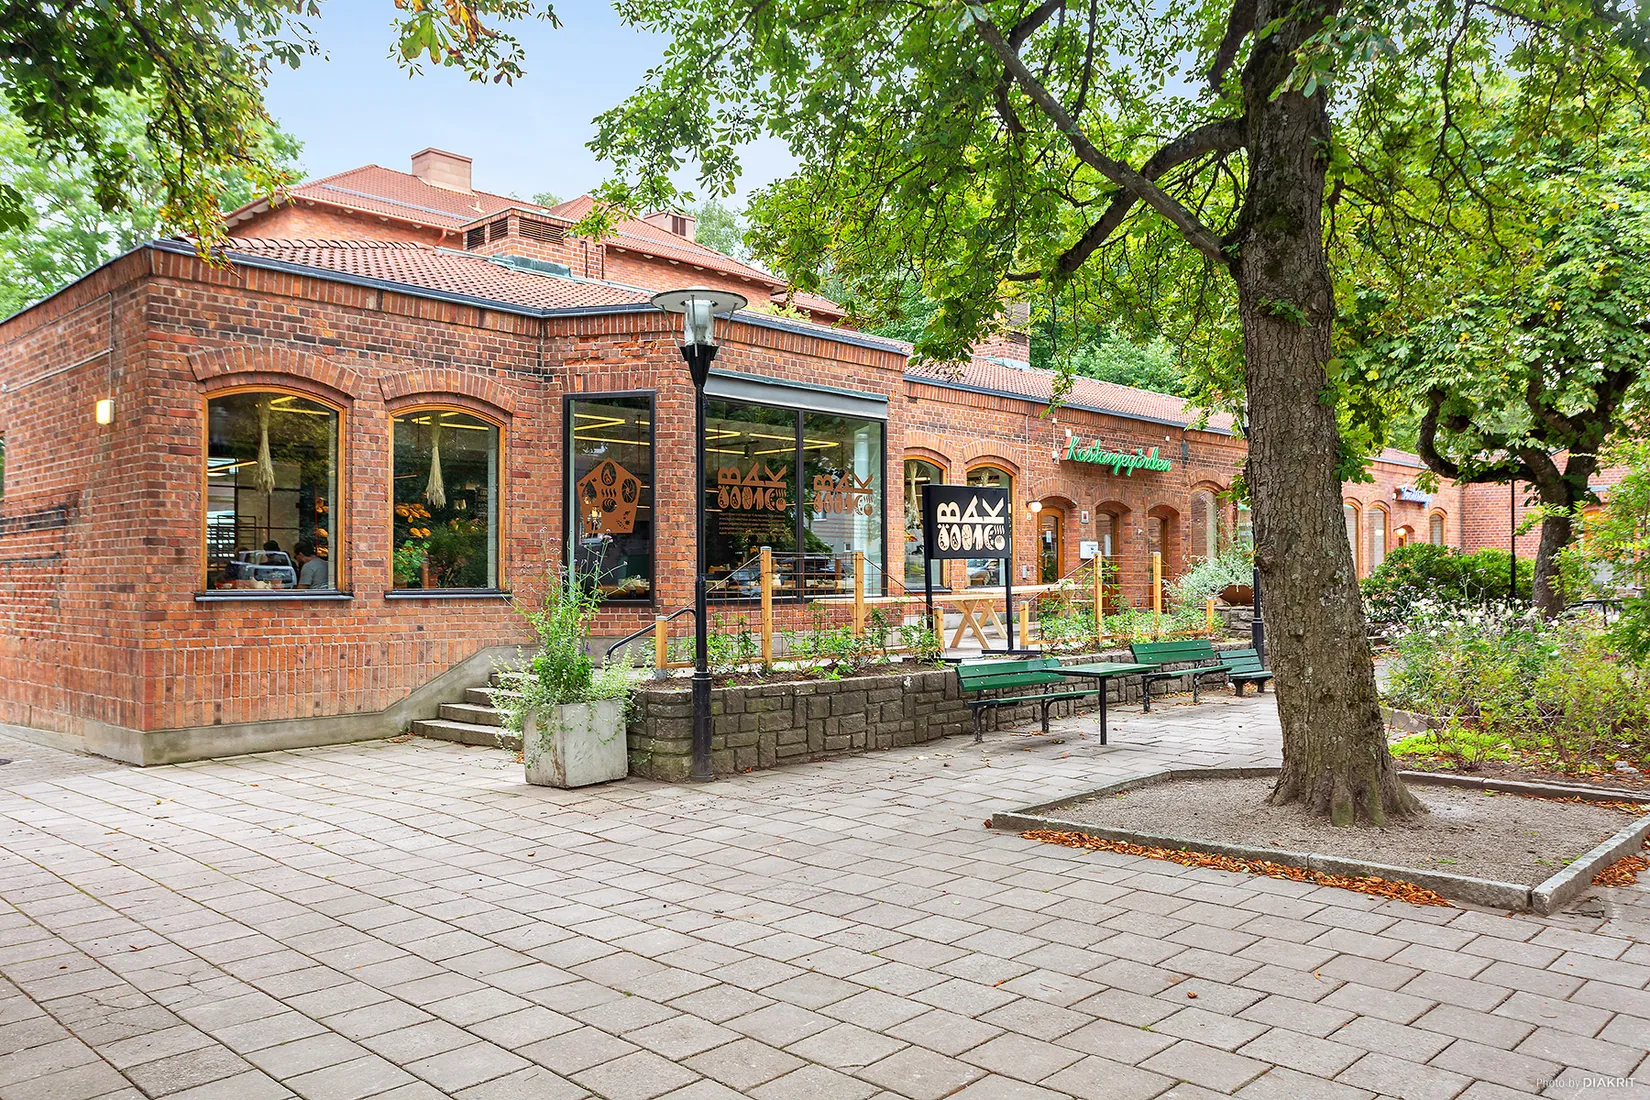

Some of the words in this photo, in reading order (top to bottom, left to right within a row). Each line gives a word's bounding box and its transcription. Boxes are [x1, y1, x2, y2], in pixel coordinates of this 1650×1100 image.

[717, 462, 787, 488] BAK
[814, 471, 873, 495] BAK
[937, 494, 1005, 524] BAK
